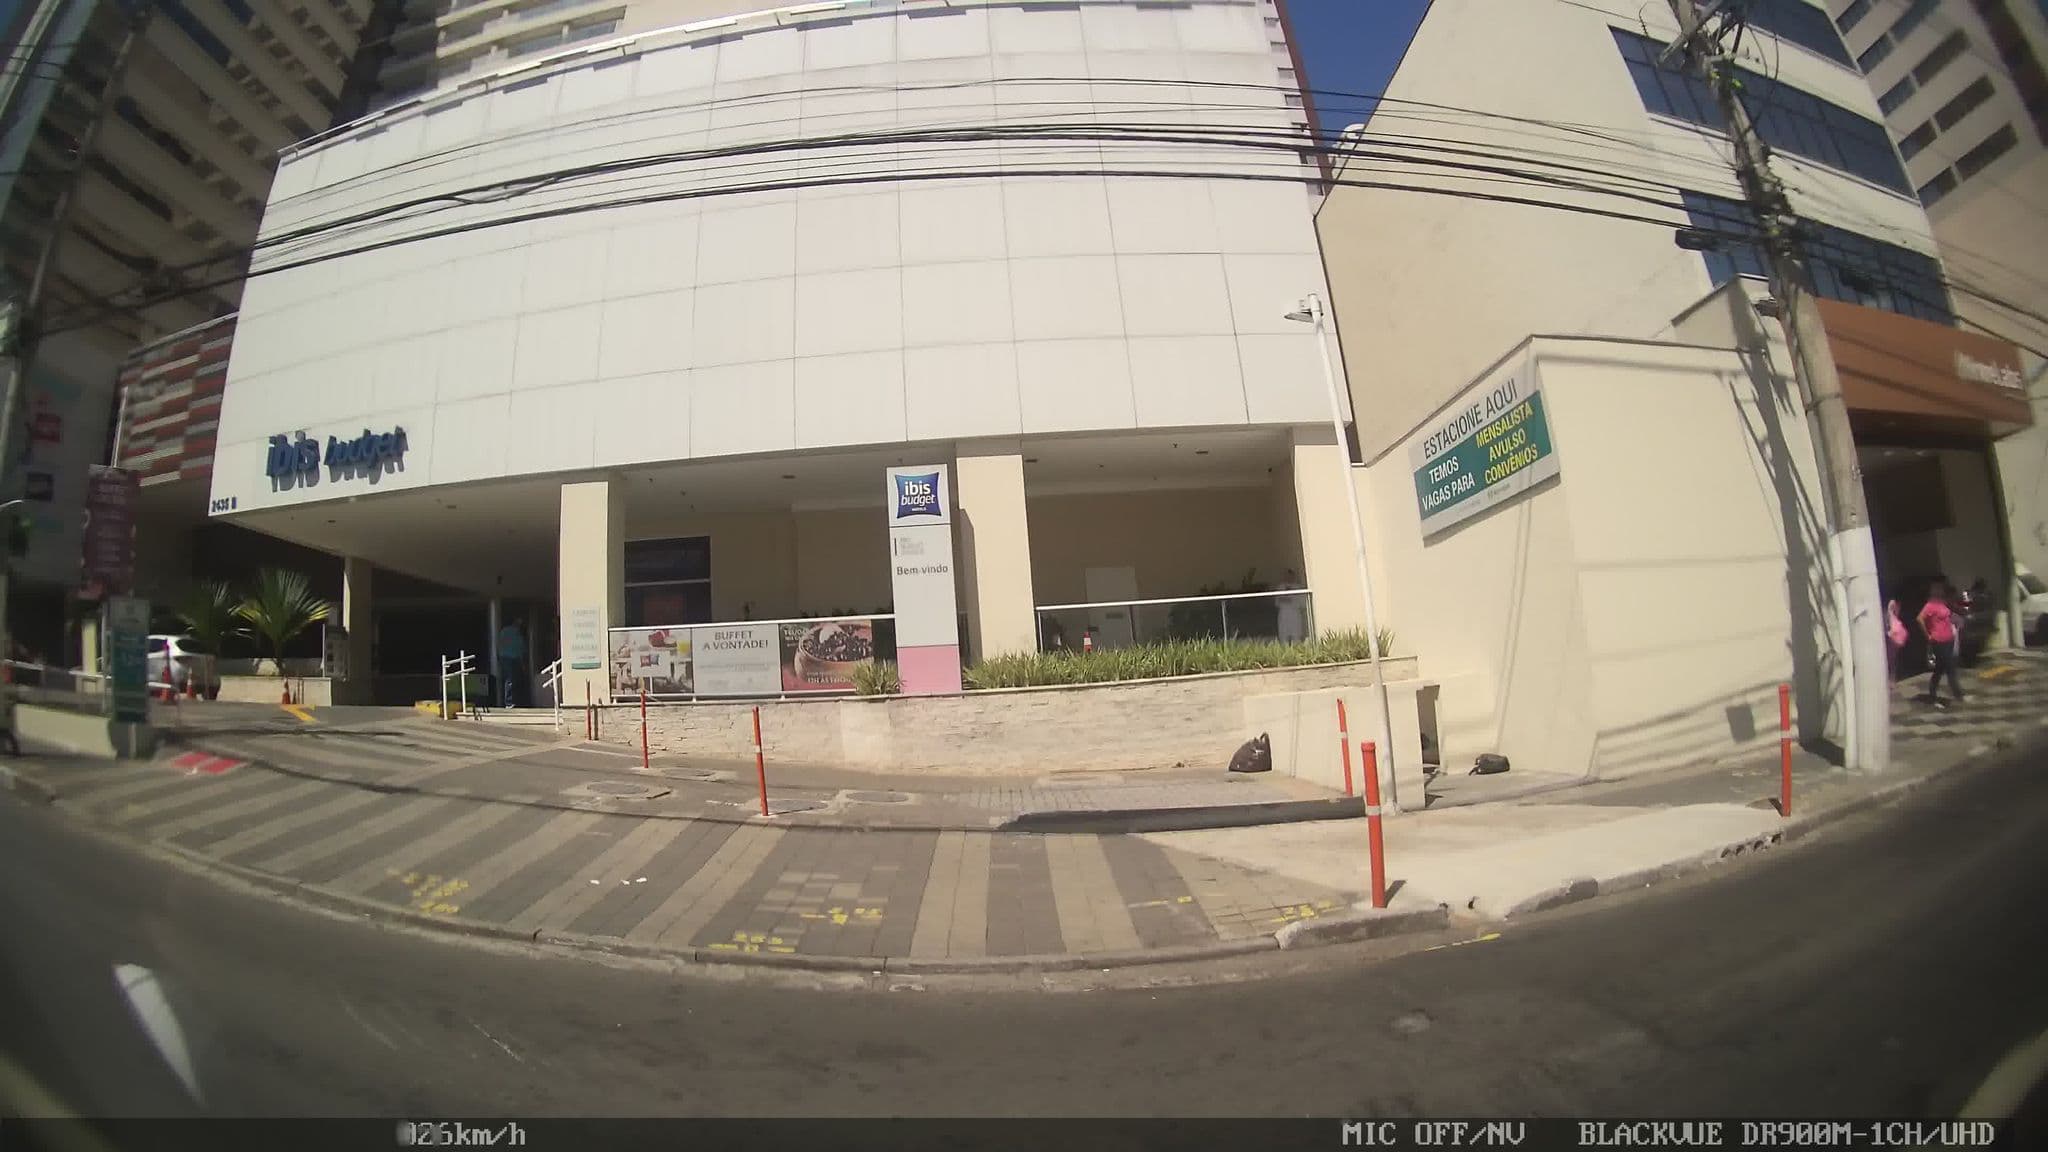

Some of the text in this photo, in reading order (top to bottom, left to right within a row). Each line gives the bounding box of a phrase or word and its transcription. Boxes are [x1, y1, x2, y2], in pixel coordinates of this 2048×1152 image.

[1423, 378, 1518, 459] ESTACIONE AQUI
[1476, 401, 1533, 448] MENSALISTA
[1489, 428, 1526, 462] AVULSO
[1428, 456, 1459, 484] TEMOS
[901, 494, 936, 507] budget
[904, 480, 931, 496] ibis
[1422, 484, 1452, 511] VAGAS
[1451, 472, 1475, 497] PARA
[715, 630, 752, 641] BUFFET
